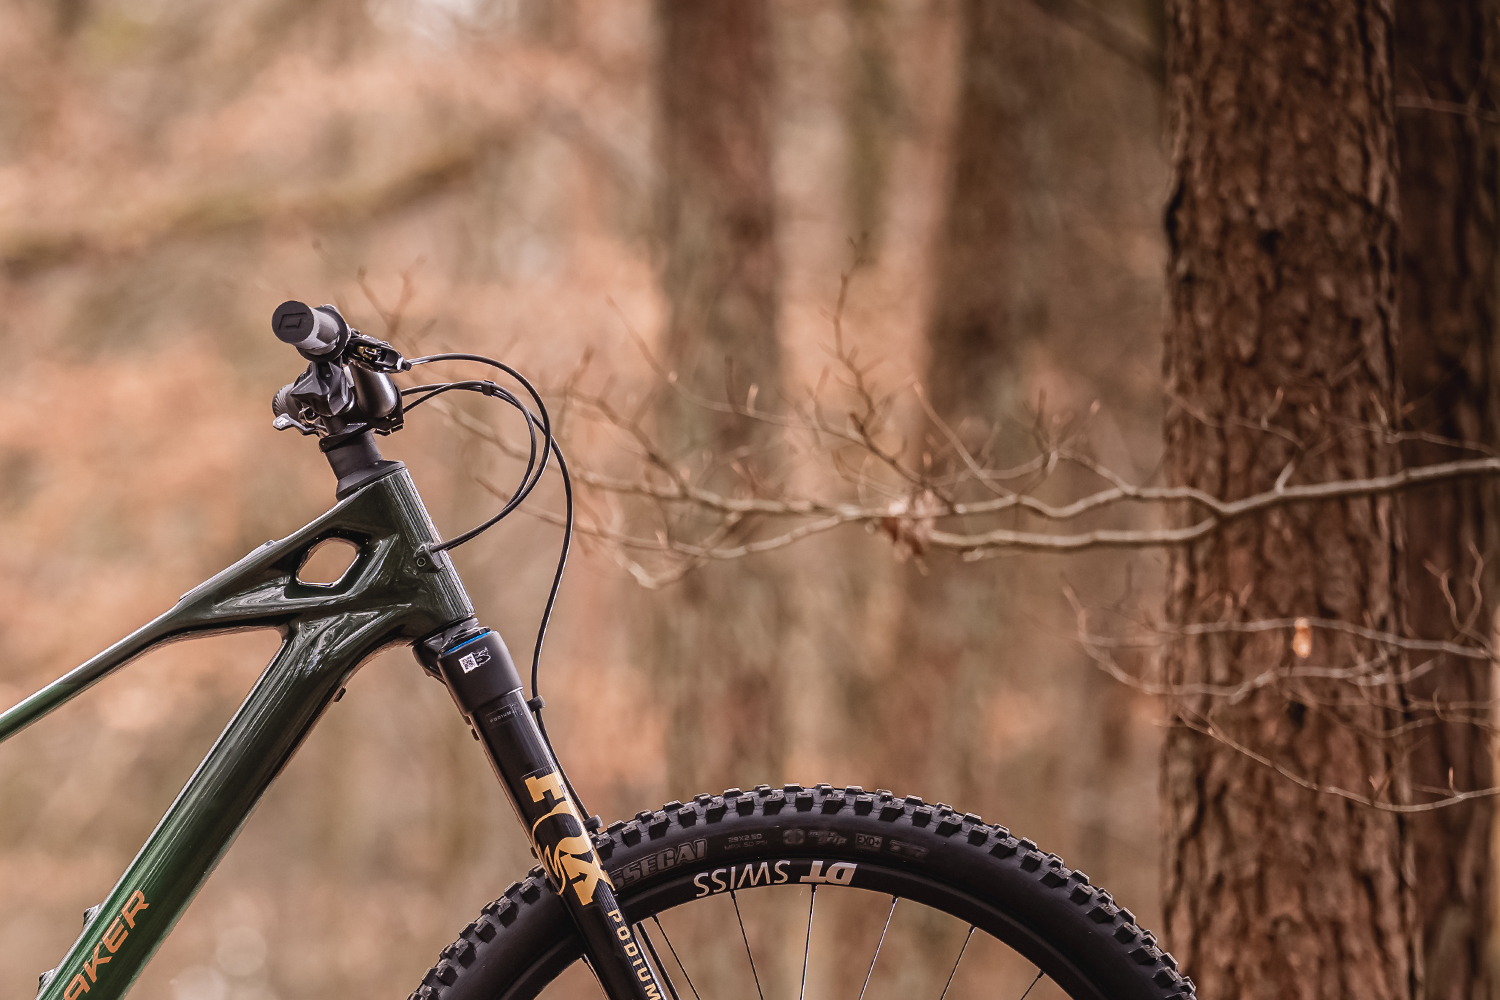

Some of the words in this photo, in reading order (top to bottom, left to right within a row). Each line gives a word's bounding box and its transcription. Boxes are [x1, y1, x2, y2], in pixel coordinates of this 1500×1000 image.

[525, 773, 615, 906] FOX
[856, 833, 882, 848] EXO+
[609, 838, 708, 891] SSEGAI
[693, 860, 791, 898] SWISS
[799, 860, 858, 886] DT
